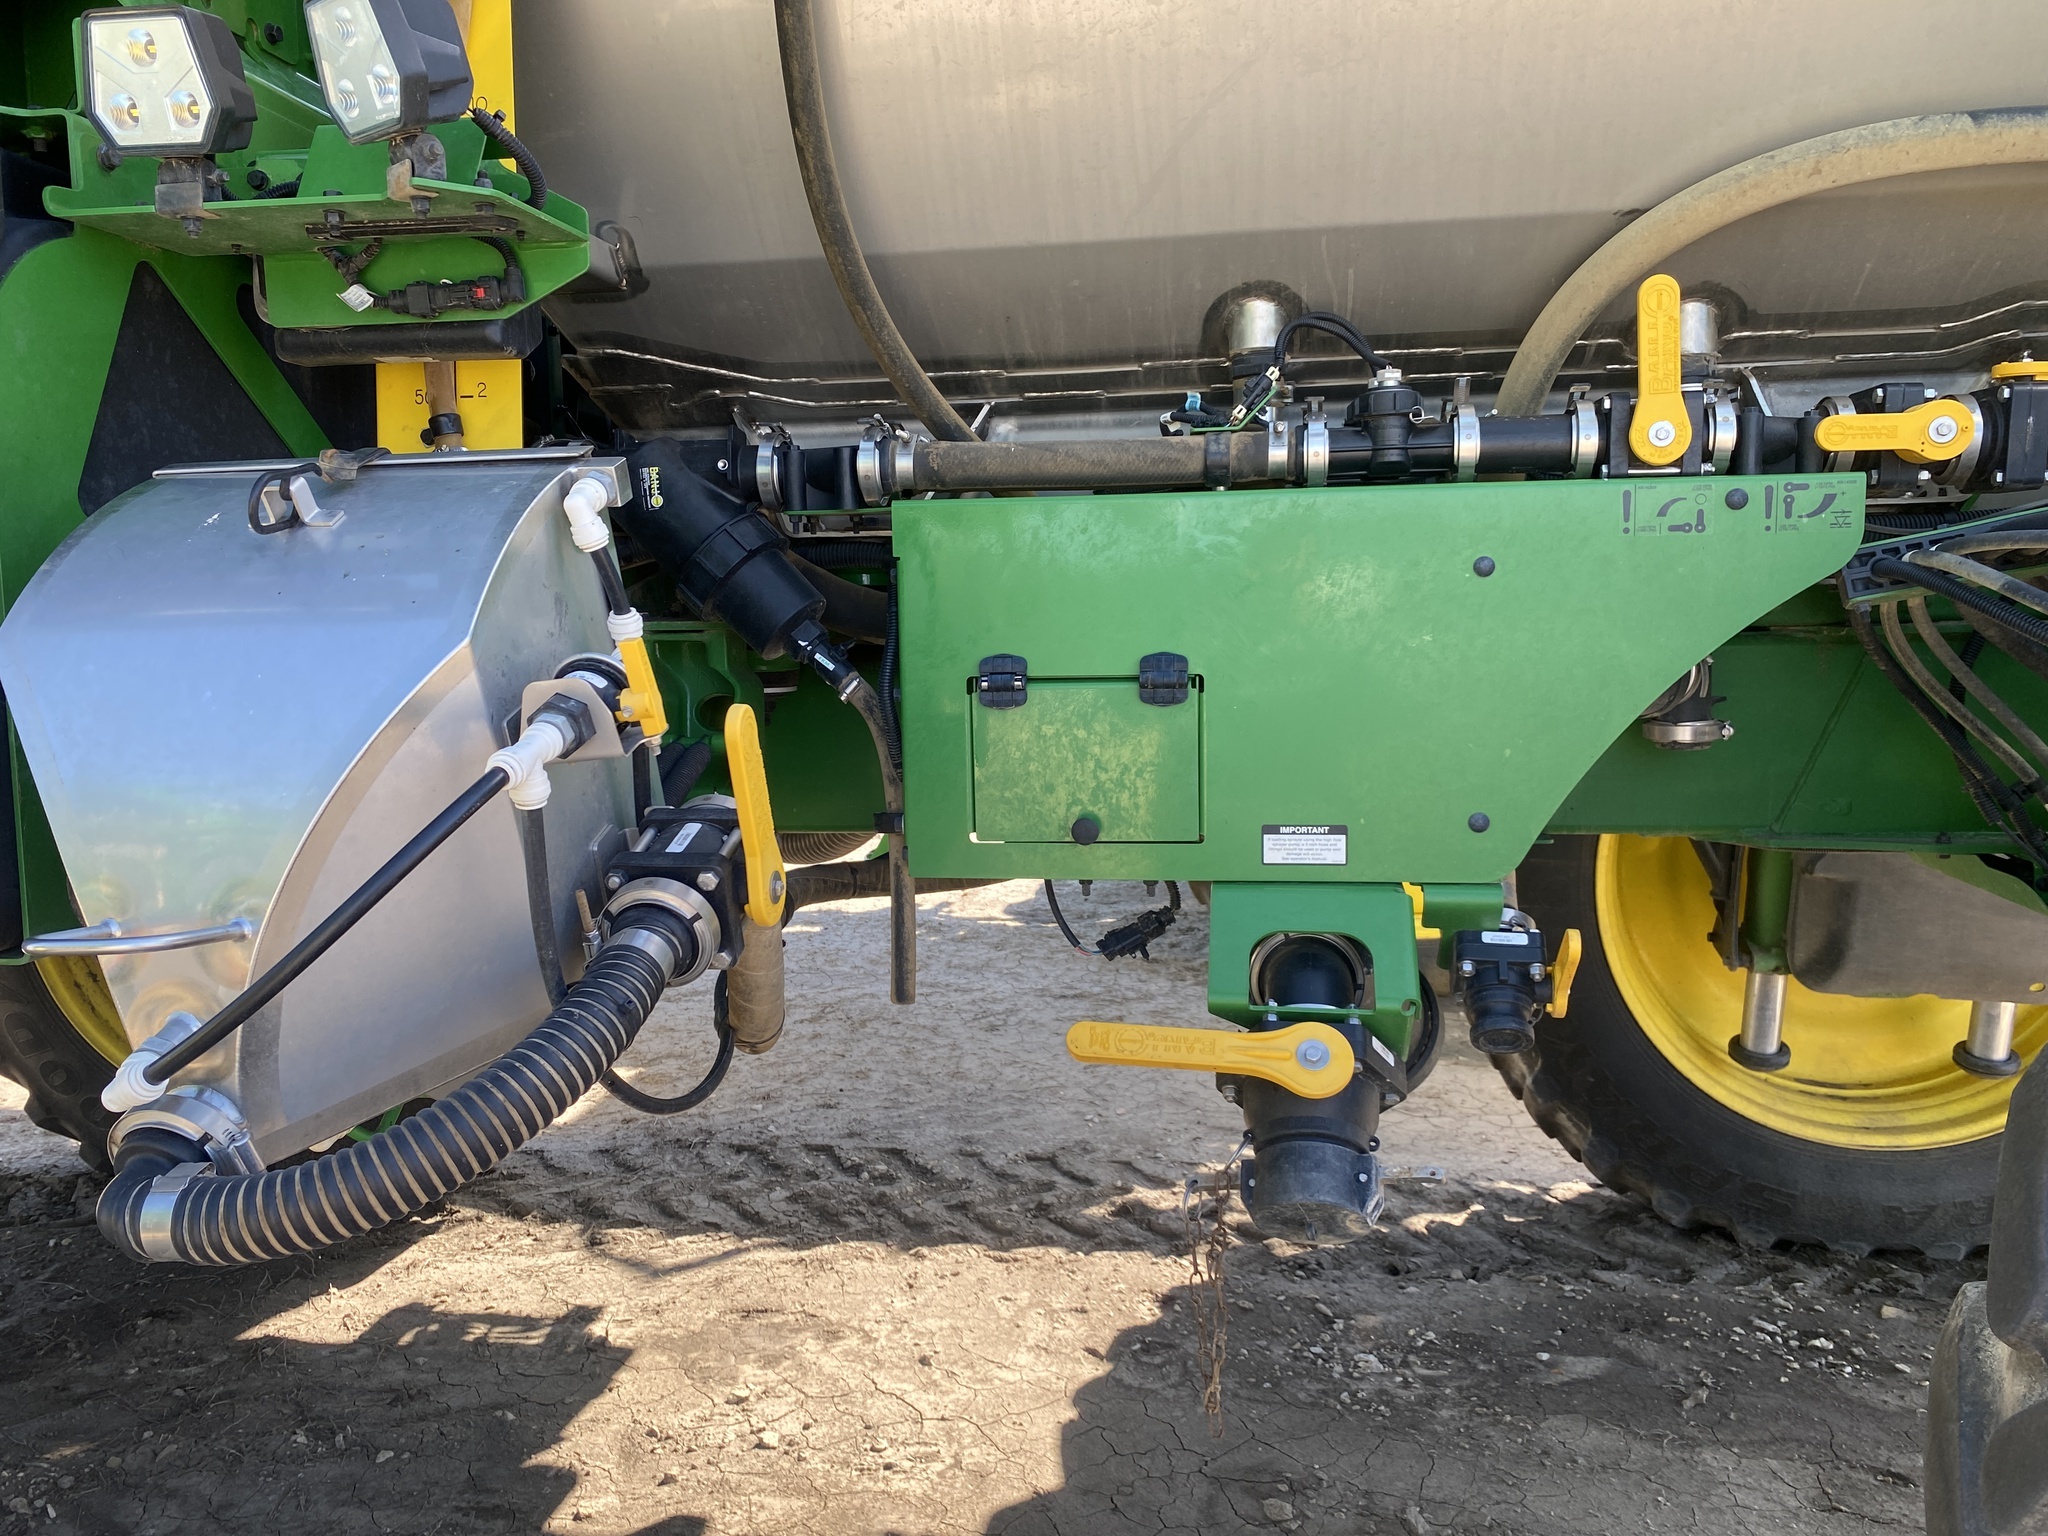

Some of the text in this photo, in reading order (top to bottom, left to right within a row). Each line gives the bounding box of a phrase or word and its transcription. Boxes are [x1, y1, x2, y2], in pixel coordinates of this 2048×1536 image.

[477, 382, 487, 398] 2
[650, 467, 664, 507] BANJO
[1279, 826, 1330, 834] IMPORTANT
